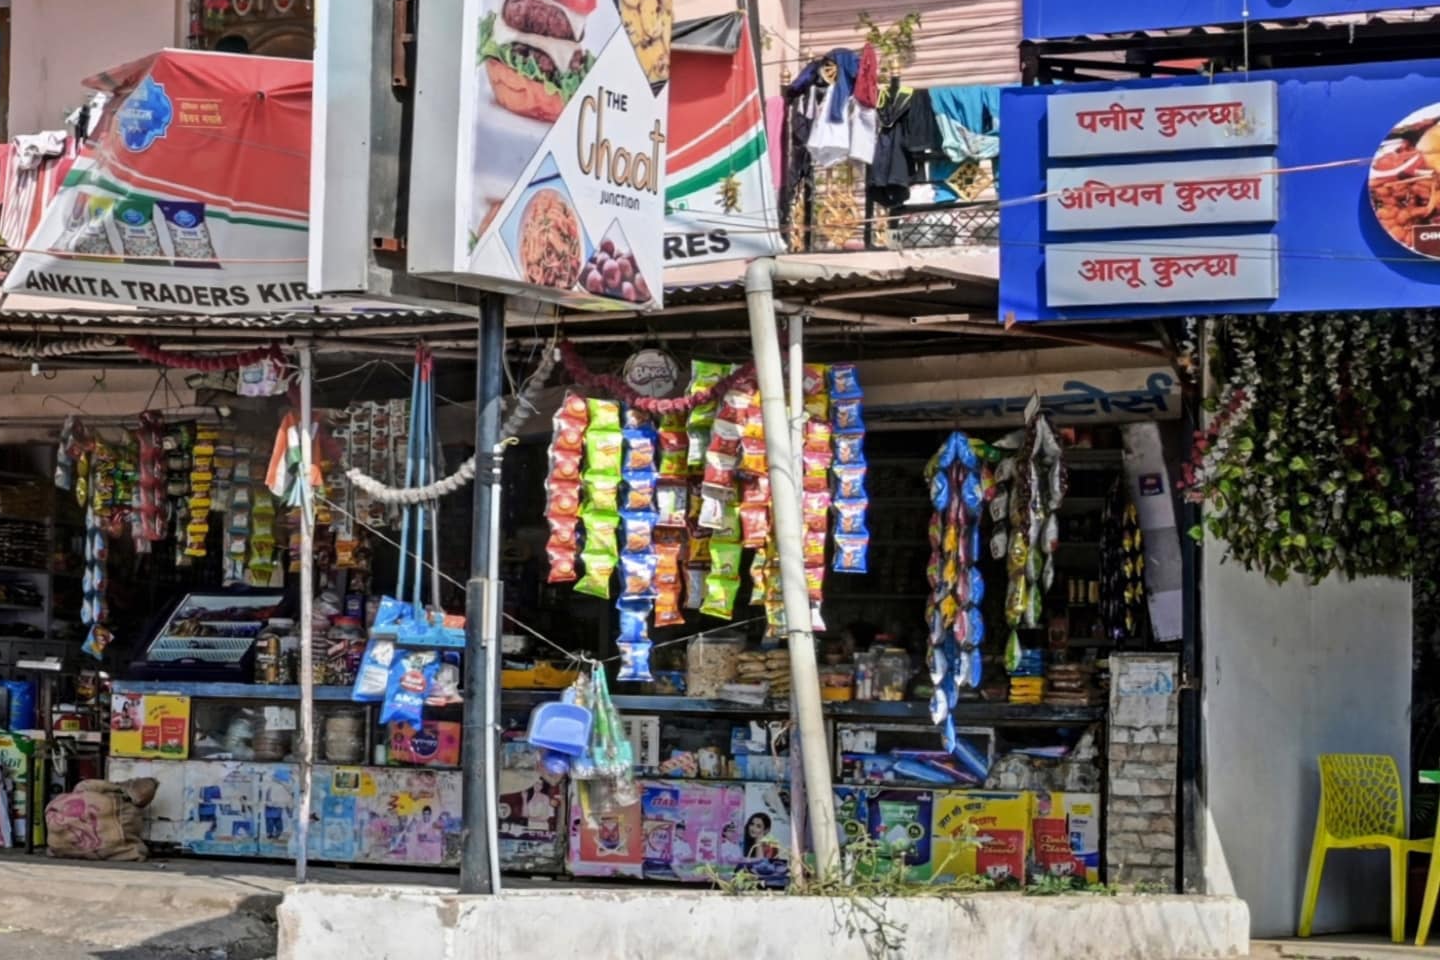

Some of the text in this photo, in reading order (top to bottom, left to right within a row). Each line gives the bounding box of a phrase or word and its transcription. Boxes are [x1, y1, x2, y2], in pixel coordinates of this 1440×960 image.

[606, 90, 628, 112] THE
[1076, 103, 1145, 133] पनीर
[577, 86, 665, 195] Chaat
[1057, 178, 1164, 210] अनियन
[25, 270, 325, 308] ANKITA TRADERS KIR
[1077, 257, 1146, 289] आलू
